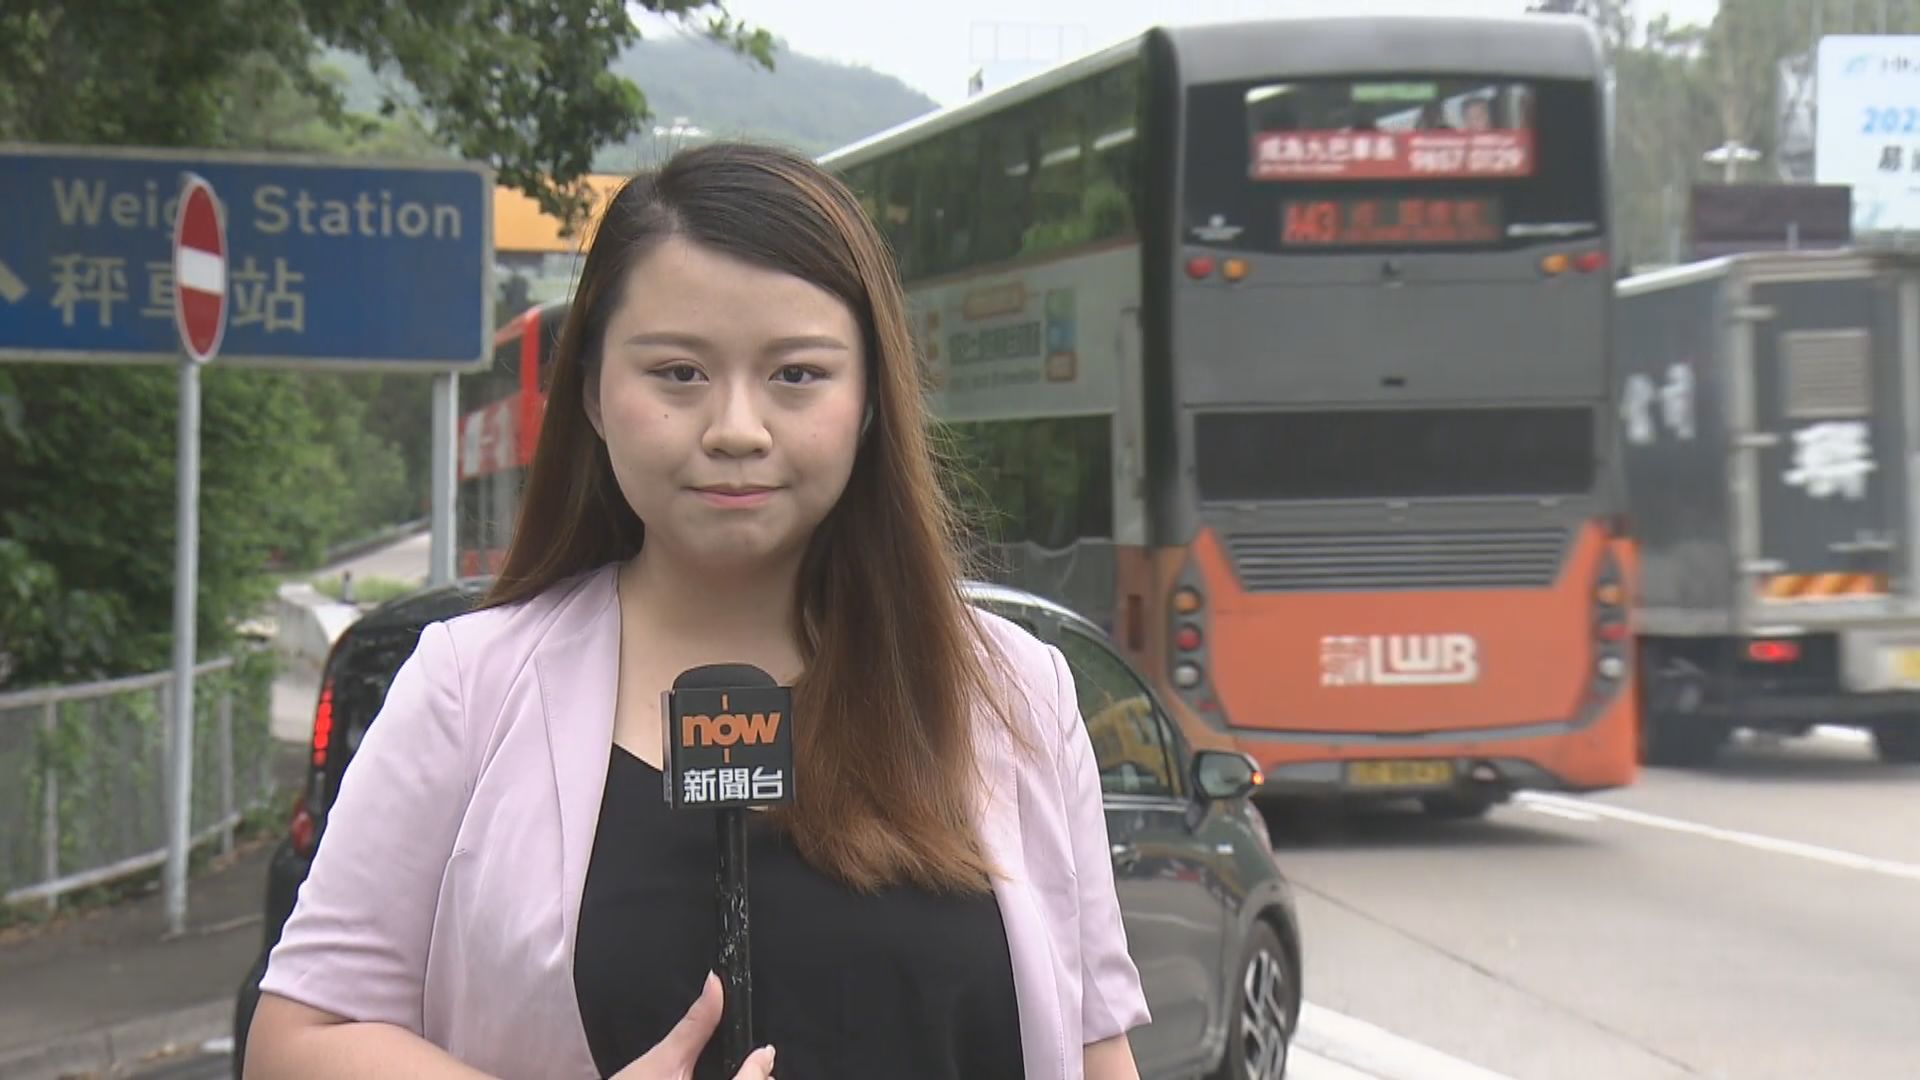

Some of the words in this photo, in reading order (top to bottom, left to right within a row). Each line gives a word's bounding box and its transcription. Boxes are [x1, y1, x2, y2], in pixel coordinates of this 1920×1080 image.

[52, 177, 228, 240] Wei
[254, 185, 462, 240] Station
[1369, 633, 1478, 686] LWB
[682, 712, 781, 748] now
[683, 766, 784, 803] 新聞台
